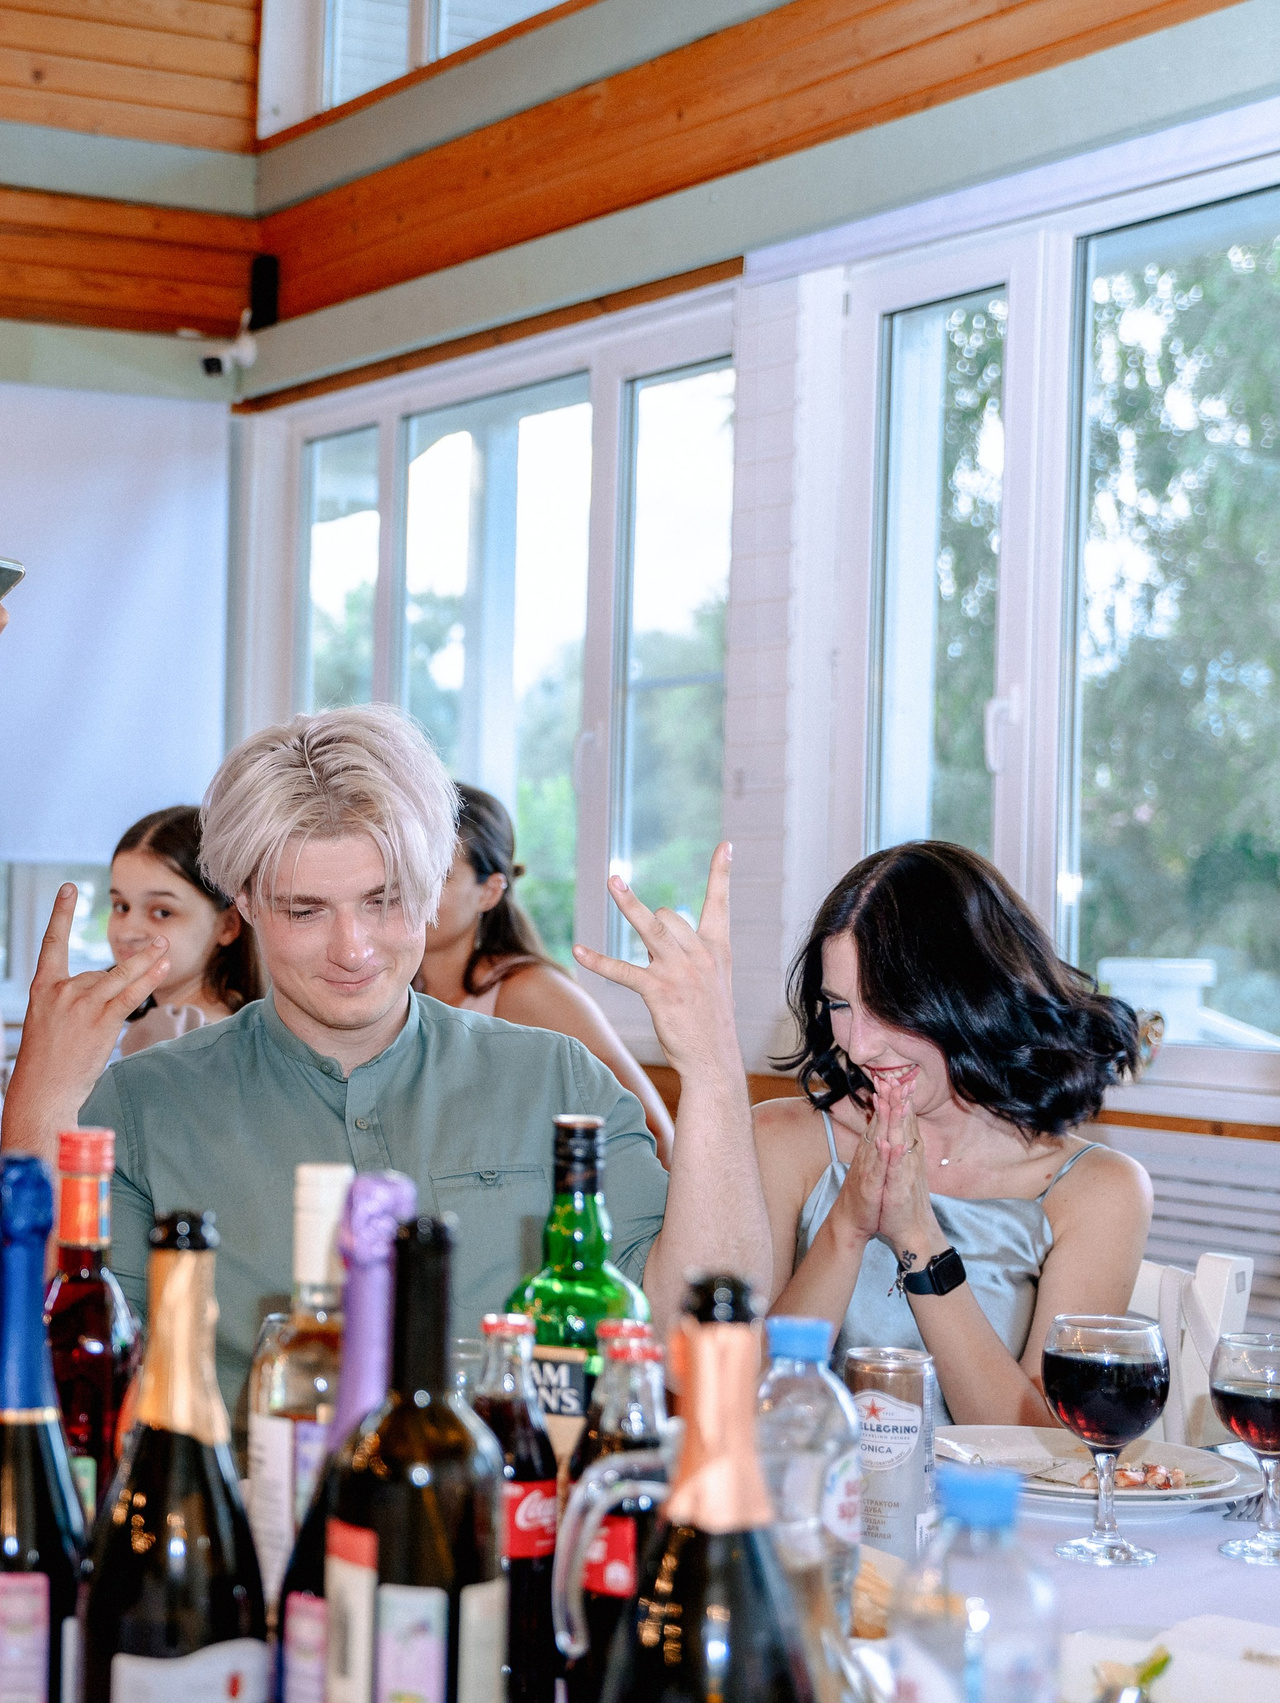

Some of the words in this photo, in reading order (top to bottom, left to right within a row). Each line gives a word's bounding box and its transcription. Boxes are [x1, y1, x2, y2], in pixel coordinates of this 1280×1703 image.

[531, 1361, 570, 1388] AM
[859, 1422, 918, 1434] ELLEGRINO
[860, 1443, 893, 1454] ONICA
[861, 1499, 900, 1508] СТРАКТОМ
[860, 1531, 891, 1539] ОКТЕЙЛЕЙ
